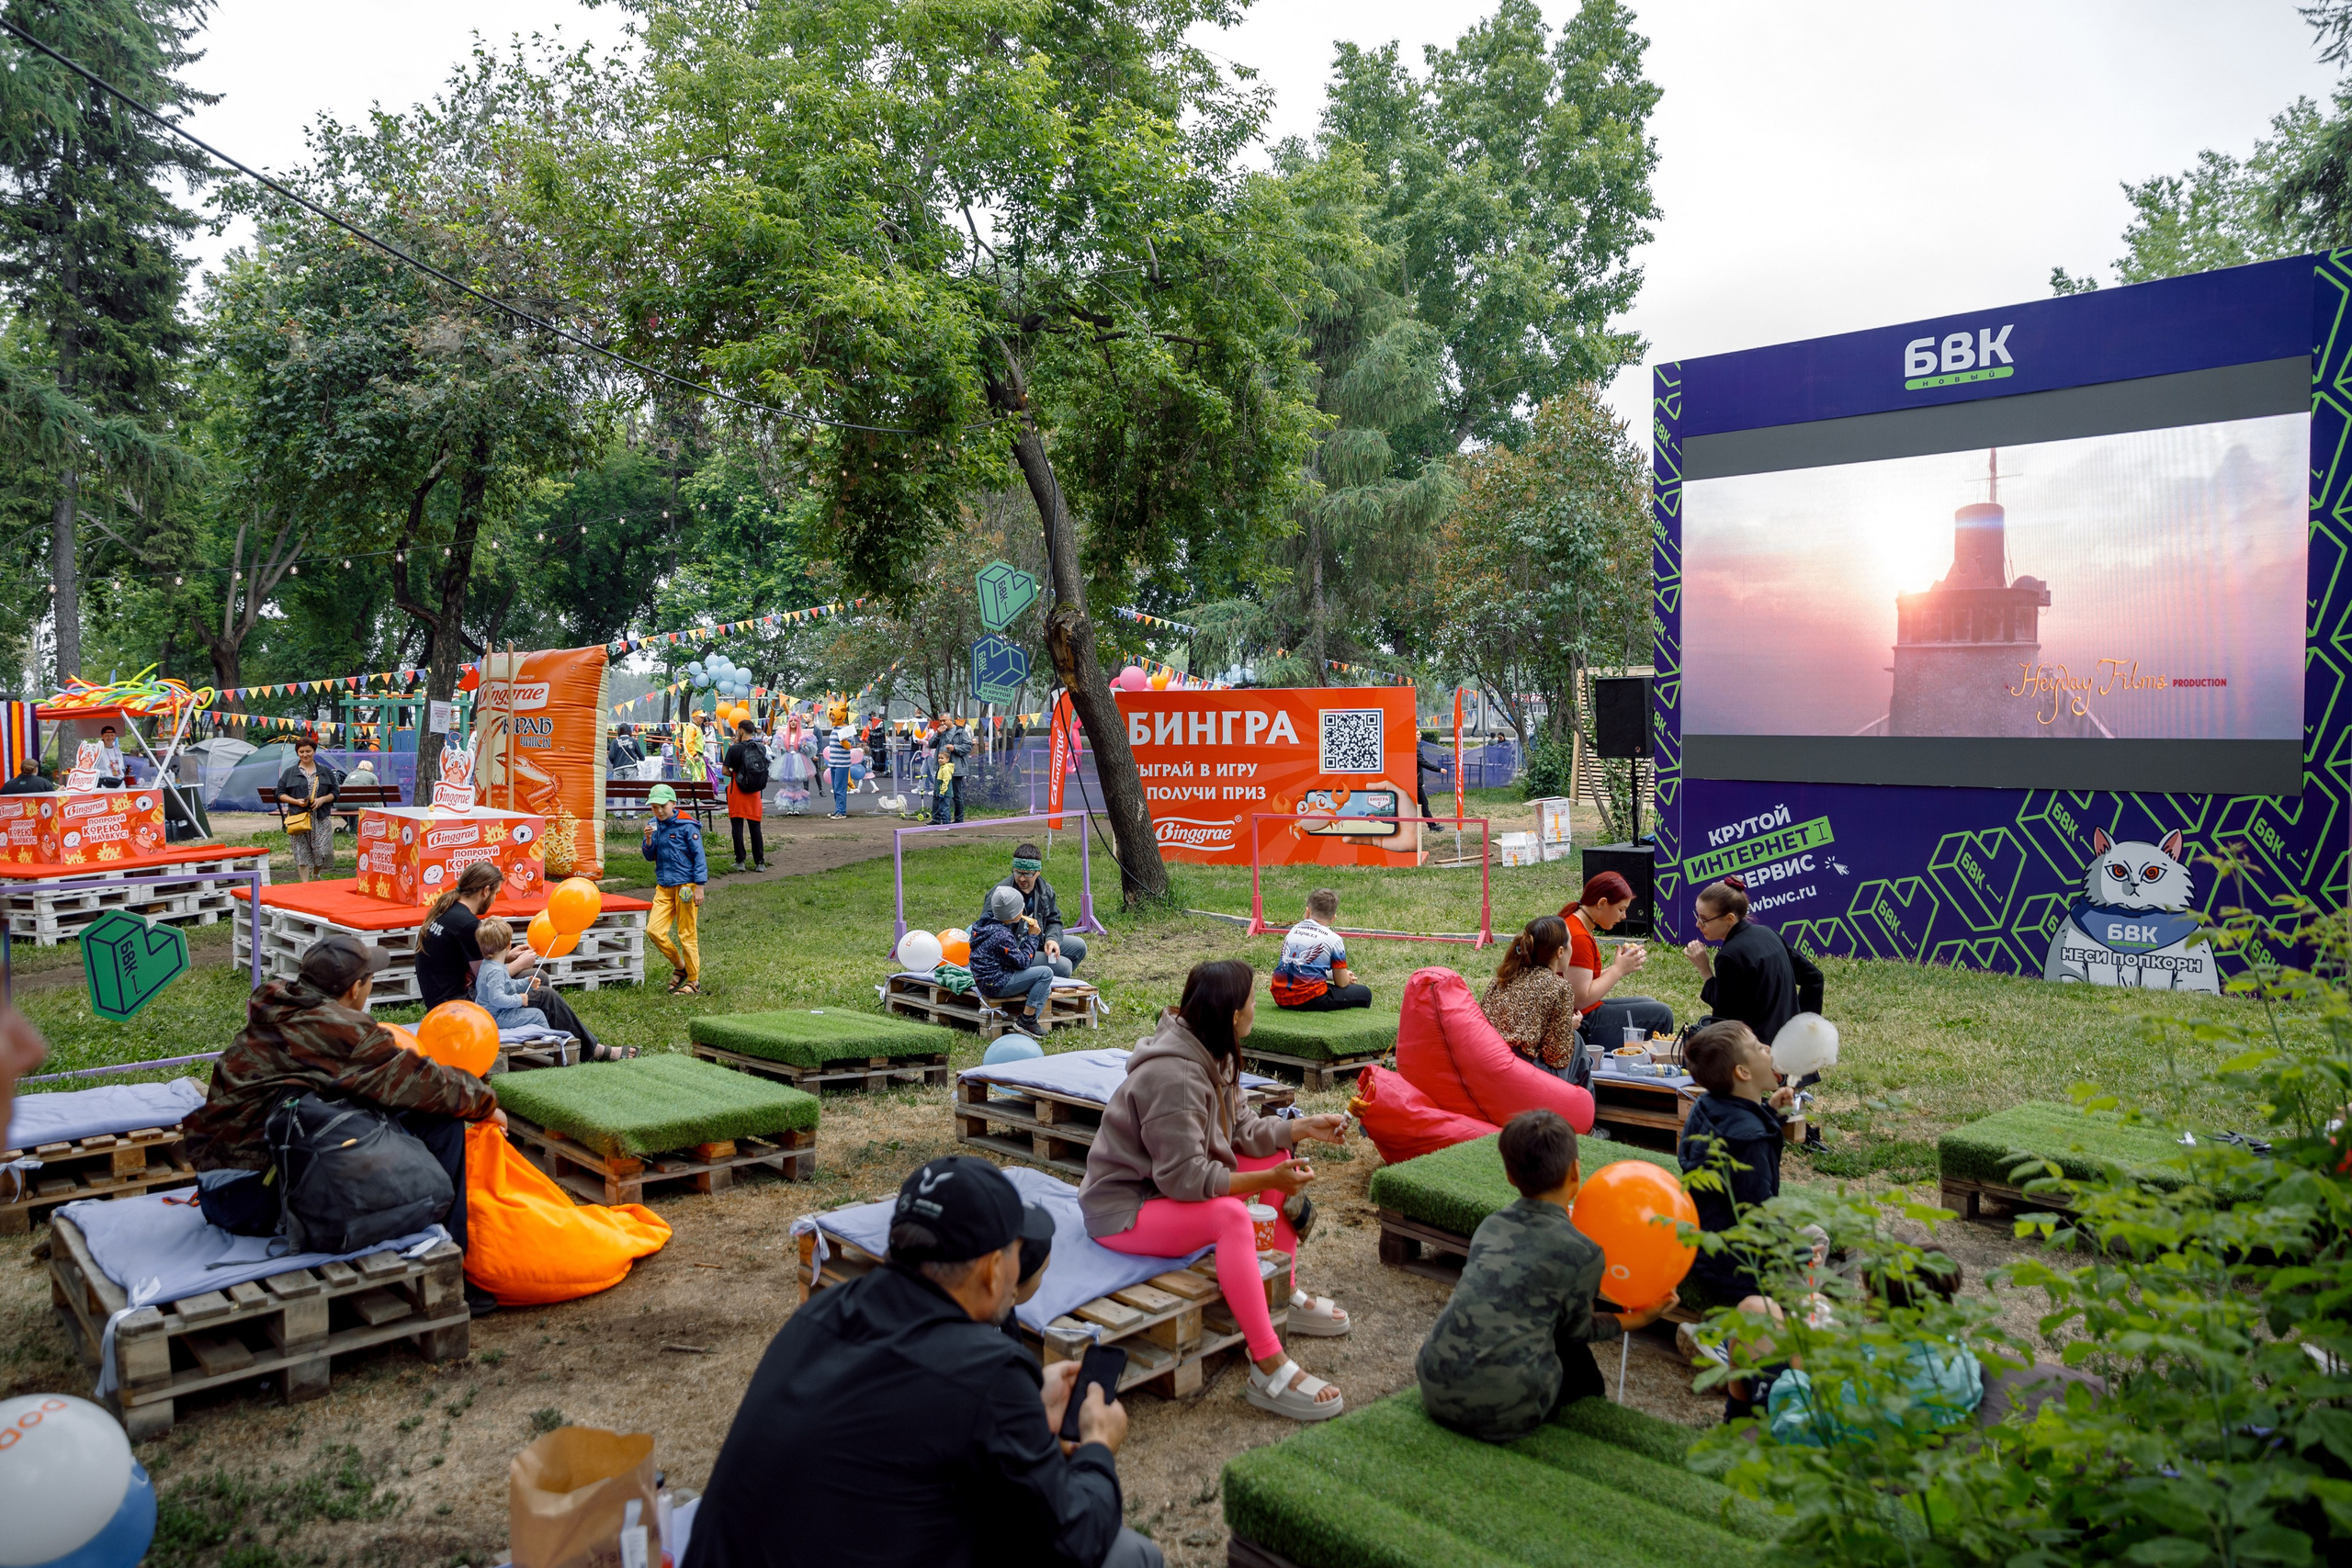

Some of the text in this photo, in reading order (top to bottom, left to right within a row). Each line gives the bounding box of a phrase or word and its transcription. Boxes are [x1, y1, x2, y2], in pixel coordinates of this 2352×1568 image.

[1905, 324, 2015, 378] БВК
[998, 580, 1009, 604] БВК
[978, 650, 988, 674] БВК
[983, 682, 1012, 692] ИНТЕРНЕТ
[2010, 658, 2227, 725] Heyday Films PRODUCTION
[1127, 710, 1300, 746] БИНГРА
[1136, 761, 1258, 778] ЫГРАЙ В ИГРУ
[435, 786, 470, 807] Binggrae
[1147, 786, 1266, 801] ПОЛУЧИ ПРИЗ
[67, 801, 106, 816] Binggrae
[88, 815, 126, 825] ПОПРОБУЙ
[84, 824, 121, 836] КОРЕЮ
[1155, 821, 1232, 844] Binggrae
[1708, 804, 1792, 847] КРУТОЙ
[2052, 802, 2079, 842] БВК
[430, 829, 476, 845] Binggrae
[2254, 817, 2285, 859] БВК
[455, 846, 499, 858] ПОПРОБУЙ
[1690, 827, 1809, 879] ИНТЕРНЕТ
[447, 858, 492, 871] КОР
[1960, 852, 1985, 890] БВК
[1877, 899, 1901, 935] БВК
[2108, 923, 2158, 943] БВК
[120, 940, 138, 978] БВК
[2061, 947, 2202, 973] НЕСИ ПОПКОРН
